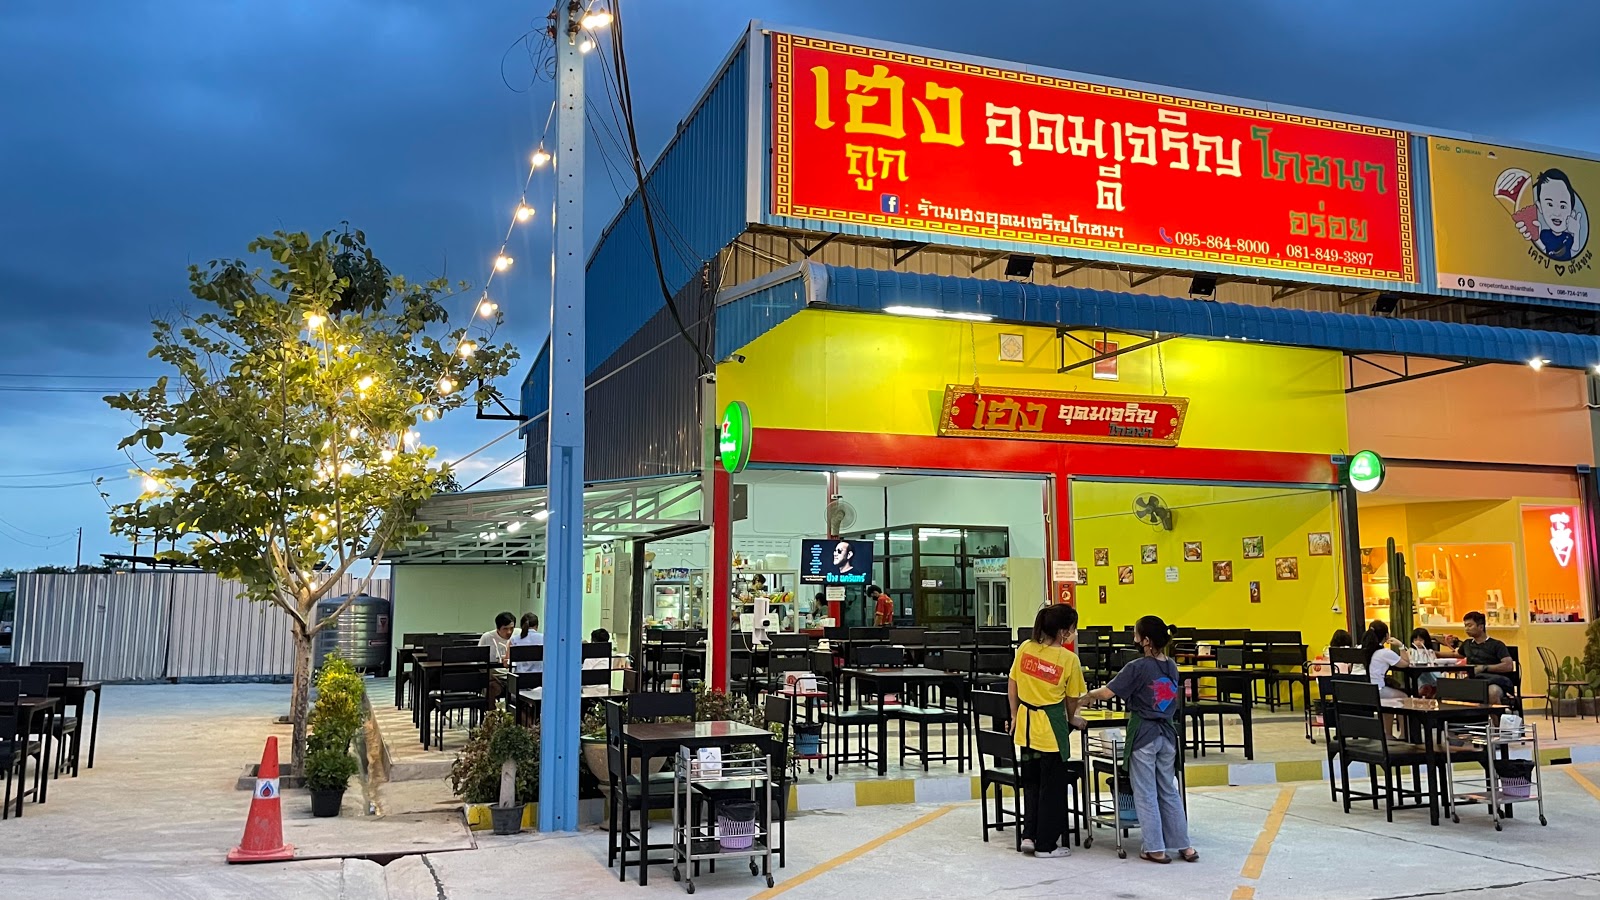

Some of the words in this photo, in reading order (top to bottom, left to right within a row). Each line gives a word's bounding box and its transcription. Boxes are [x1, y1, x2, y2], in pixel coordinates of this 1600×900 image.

[810, 64, 965, 147] เฮง
[985, 102, 1243, 177] อุดมเจริญ
[845, 143, 909, 191] ถูก
[1096, 163, 1125, 212] ดี
[1289, 200, 1368, 242] อร่อย
[1175, 231, 1270, 255] 095-864-8000
[1286, 244, 1374, 265] 081-849-3897
[972, 397, 1047, 431] เฮง
[1058, 402, 1159, 425] อุดมเจริญ
